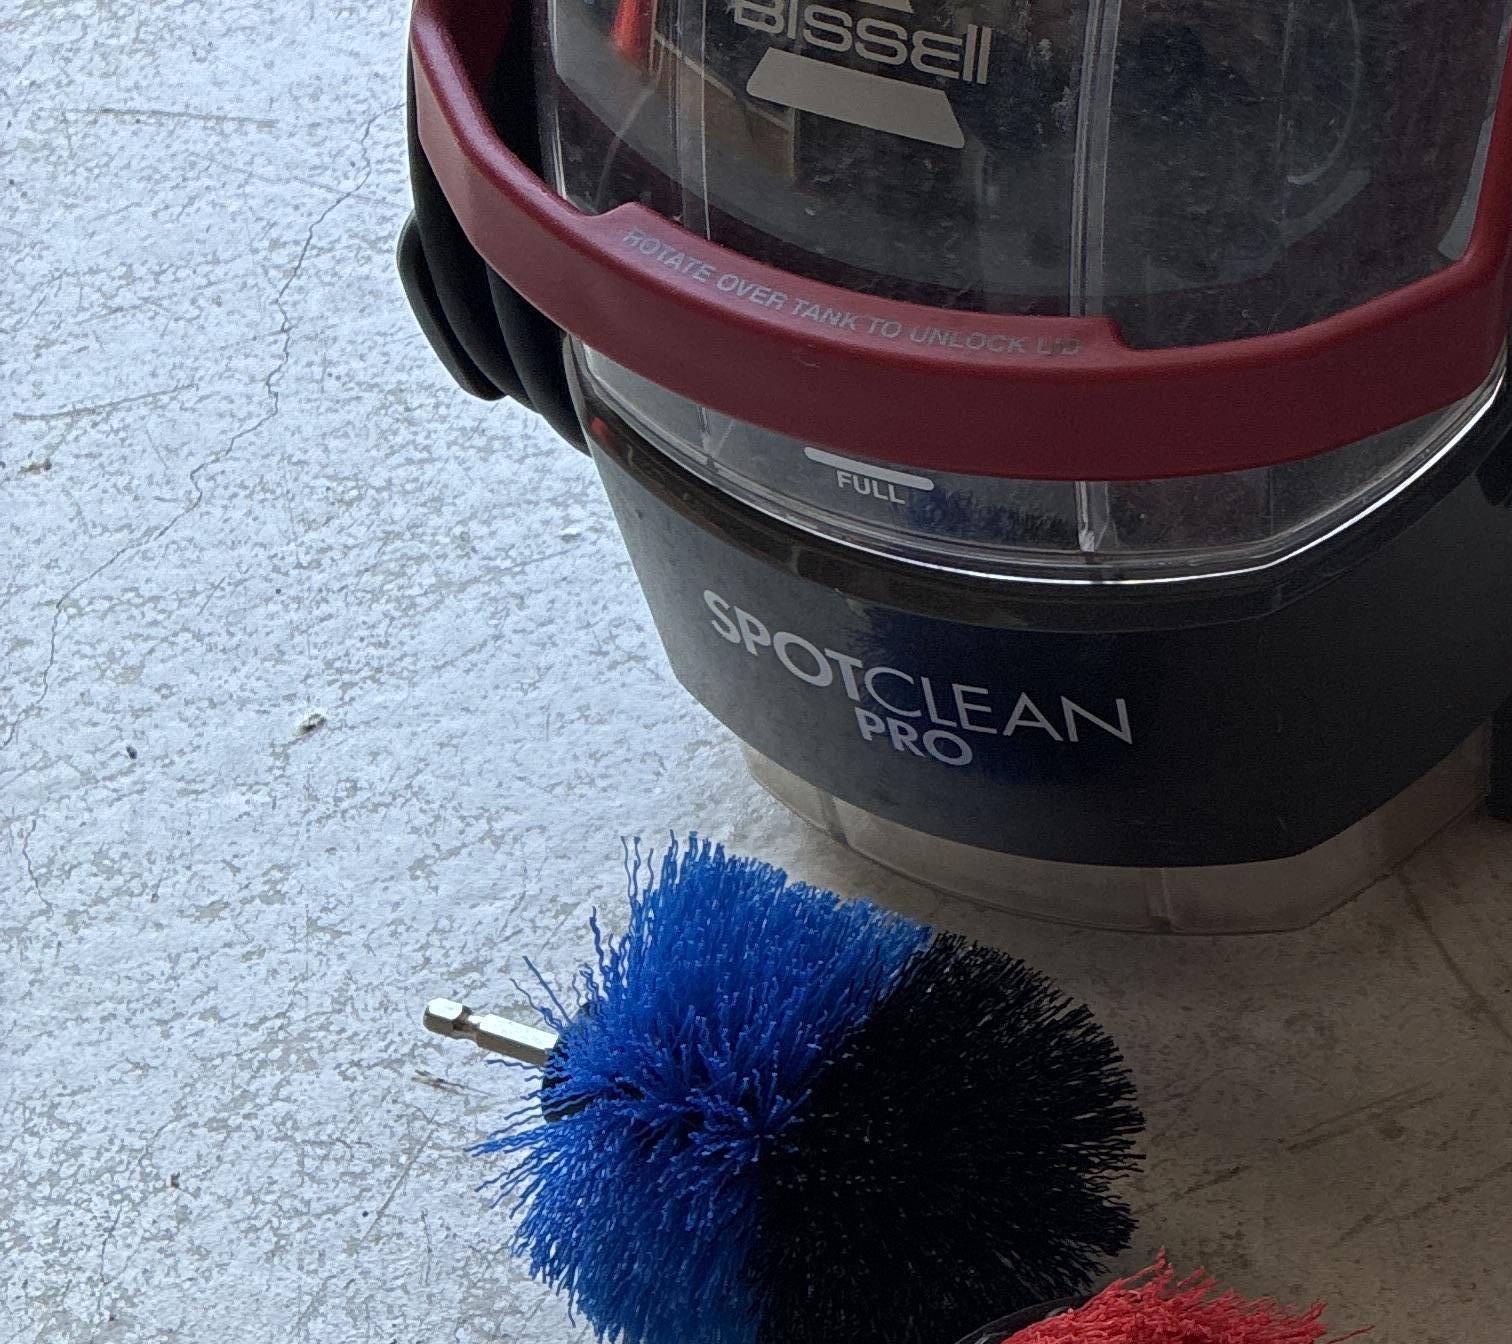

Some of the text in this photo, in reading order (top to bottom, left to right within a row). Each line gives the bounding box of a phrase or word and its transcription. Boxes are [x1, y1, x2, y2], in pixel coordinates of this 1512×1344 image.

[622, 227, 717, 284] ROTATE
[716, 272, 789, 312] OVER
[791, 297, 857, 331] TANK
[868, 315, 903, 339] TO
[909, 325, 1027, 355] UNLOCK
[836, 469, 907, 505] FULL
[854, 705, 975, 767] PRO
